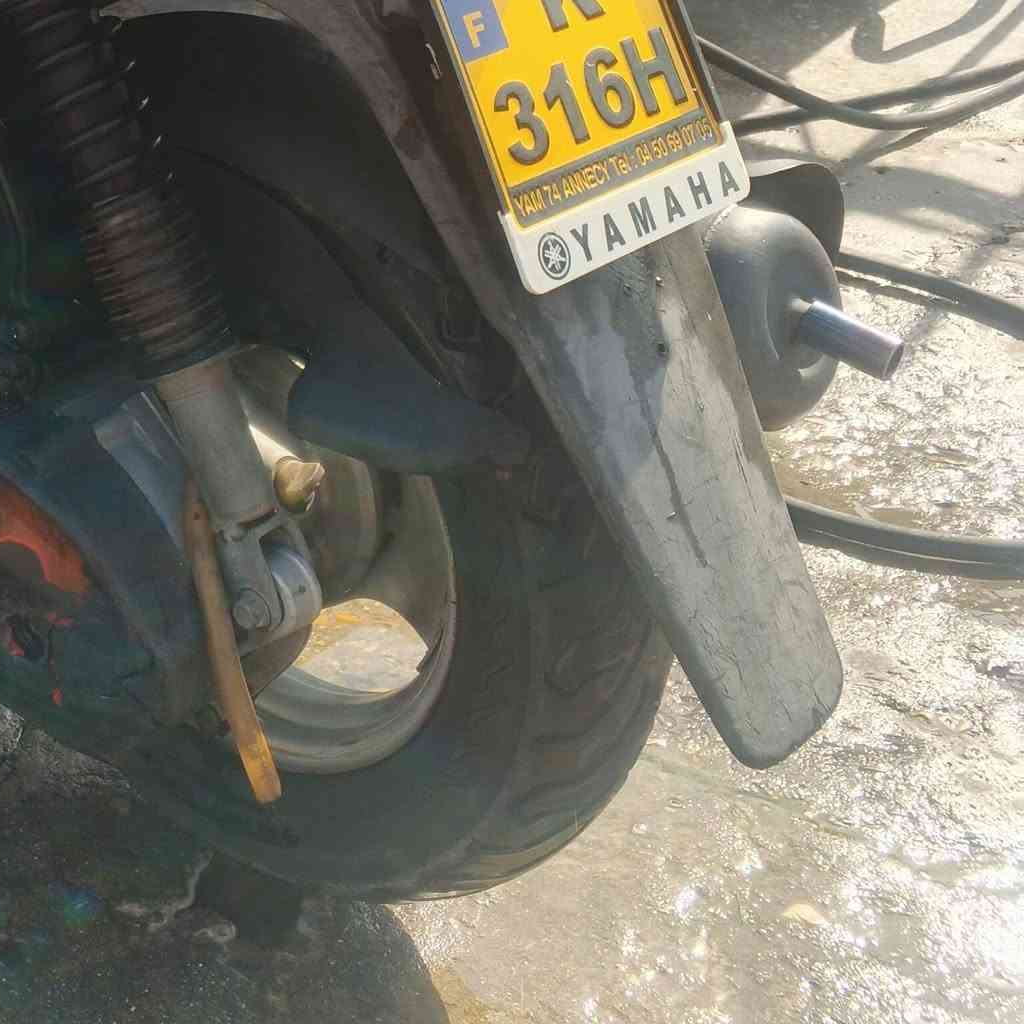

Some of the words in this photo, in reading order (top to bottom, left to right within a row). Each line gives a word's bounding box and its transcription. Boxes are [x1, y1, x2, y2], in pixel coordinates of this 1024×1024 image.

[463, 10, 485, 49] F
[494, 27, 689, 166] 316H
[514, 188, 547, 217] YAM
[561, 160, 610, 198] ANNECY
[570, 161, 741, 263] YAMAHA
